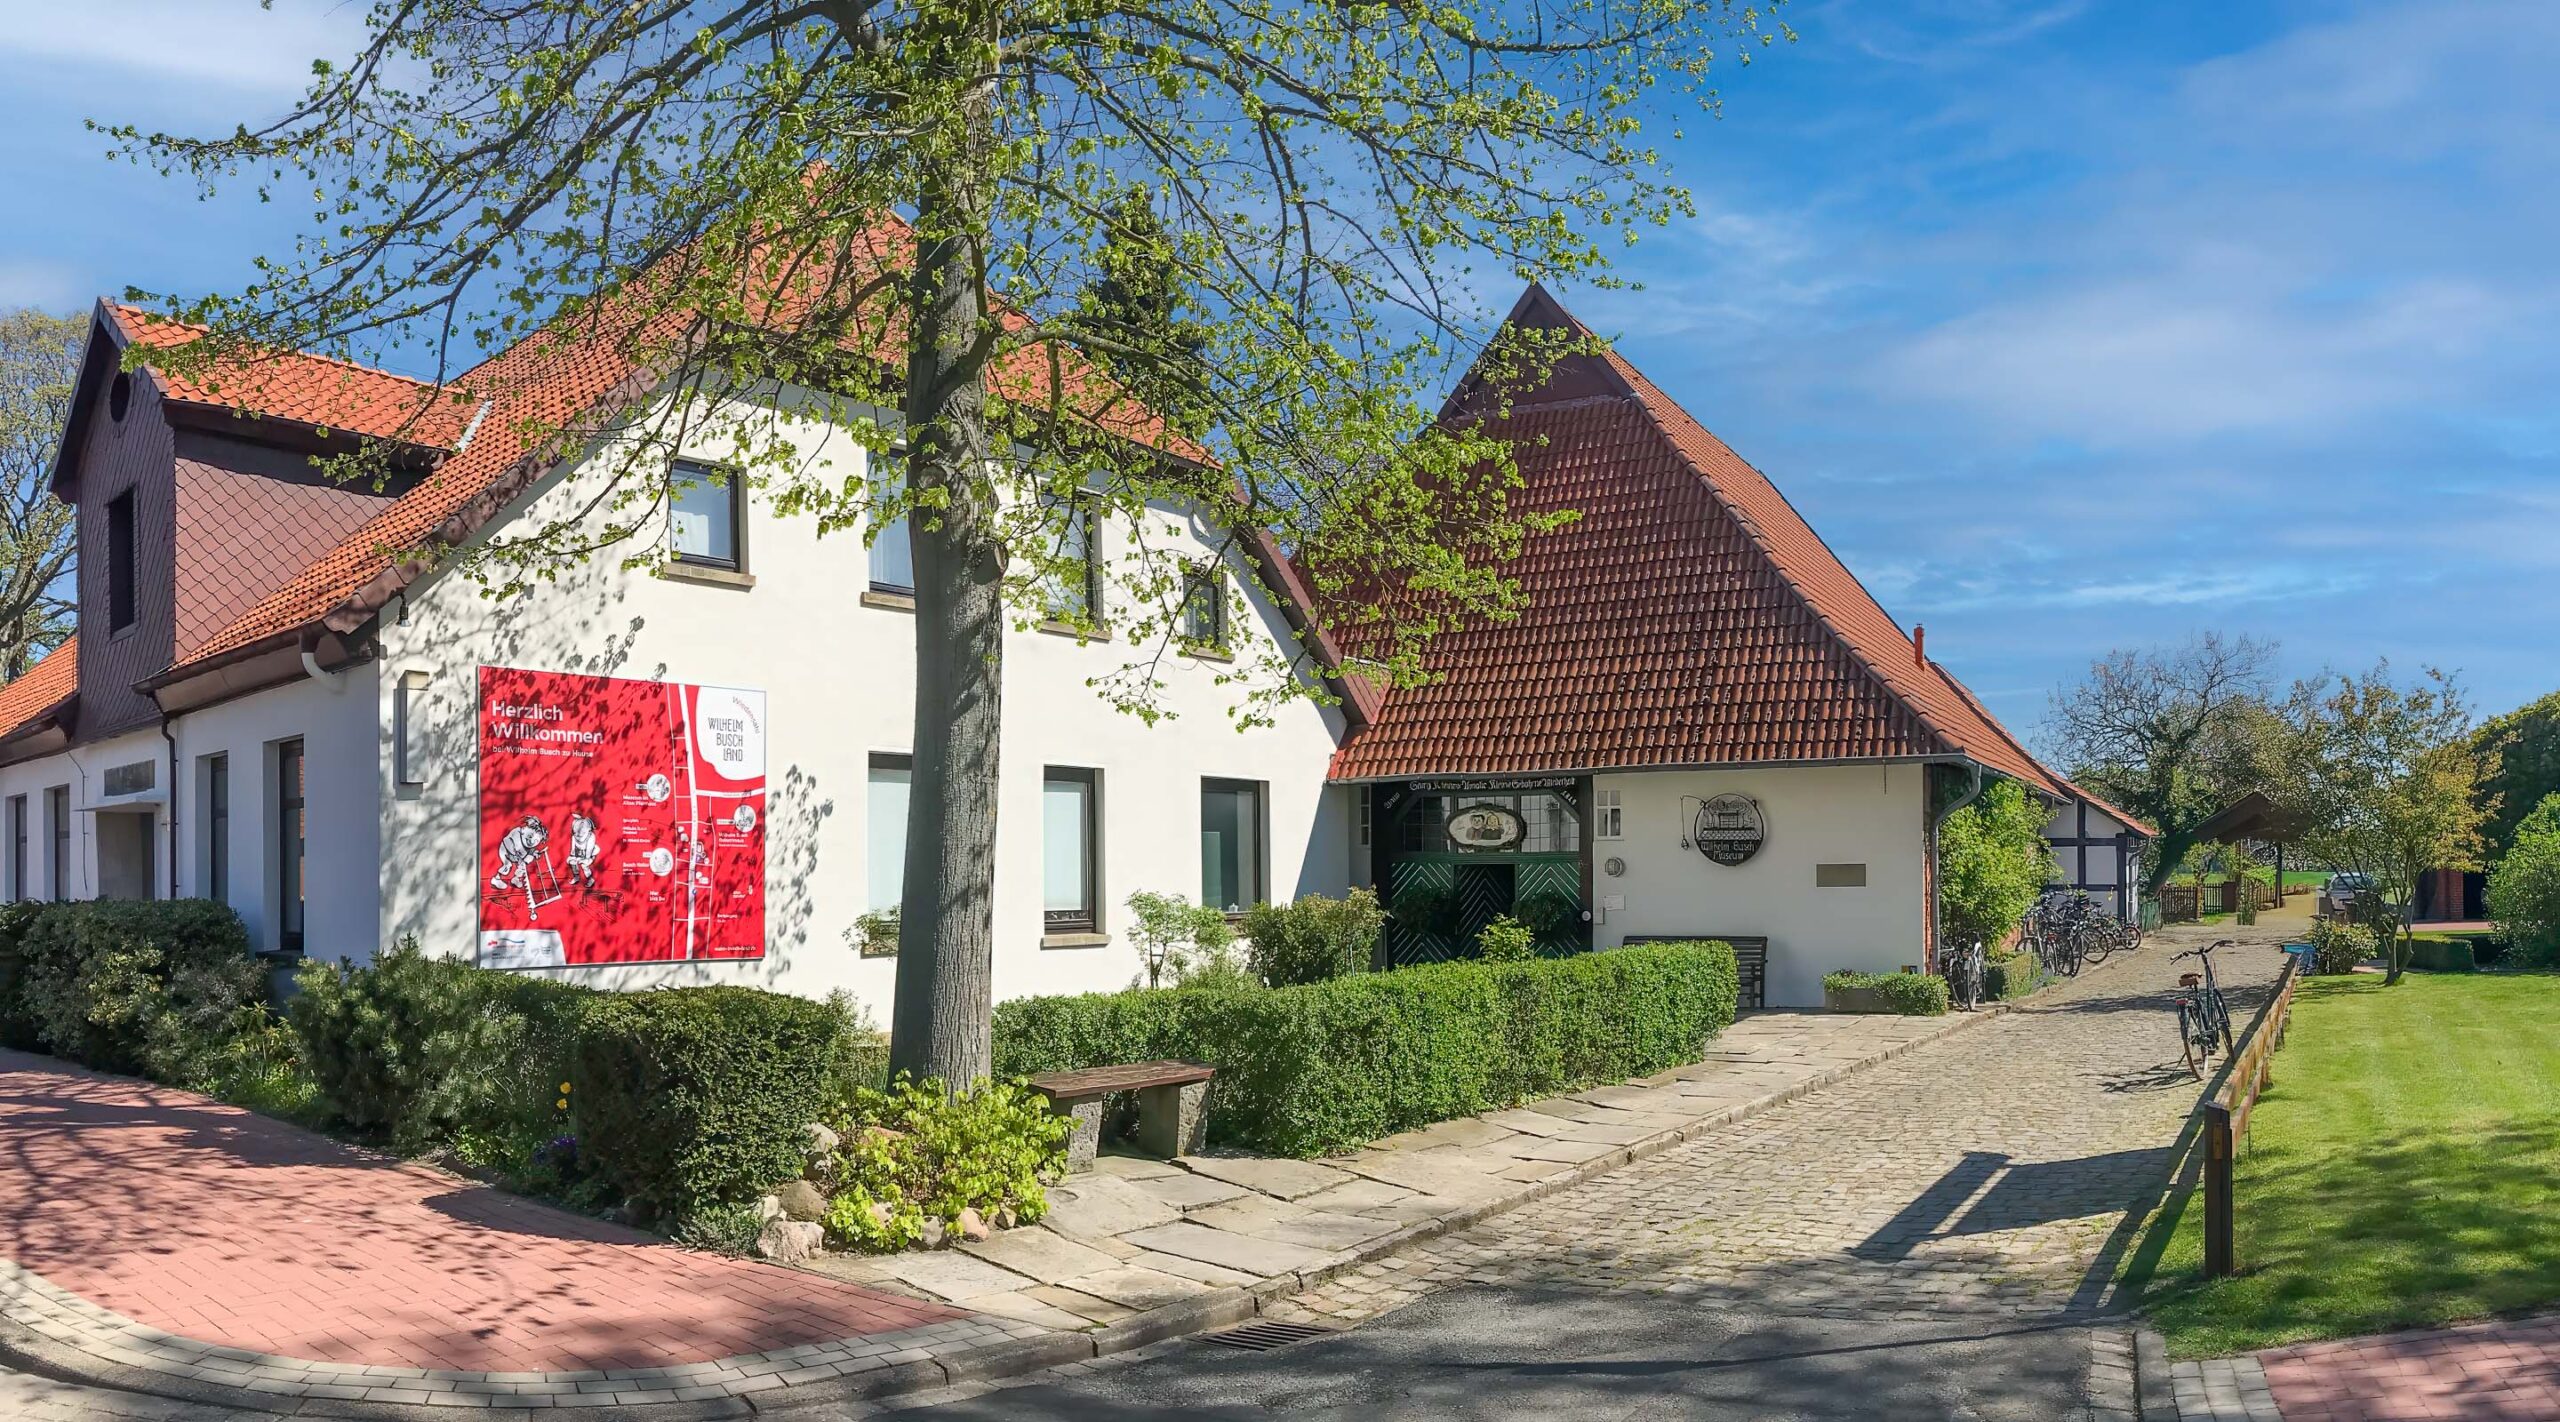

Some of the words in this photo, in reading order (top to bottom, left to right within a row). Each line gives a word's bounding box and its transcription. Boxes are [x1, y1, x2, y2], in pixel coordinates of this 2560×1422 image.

[492, 700, 563, 721] Herzlich
[708, 717, 744, 732] WILHELM
[491, 721, 604, 744] Willkommen
[716, 732, 744, 747] BUSCH
[540, 748, 560, 756] Busch
[723, 748, 744, 762] LAND
[1712, 850, 1744, 860] Museum
